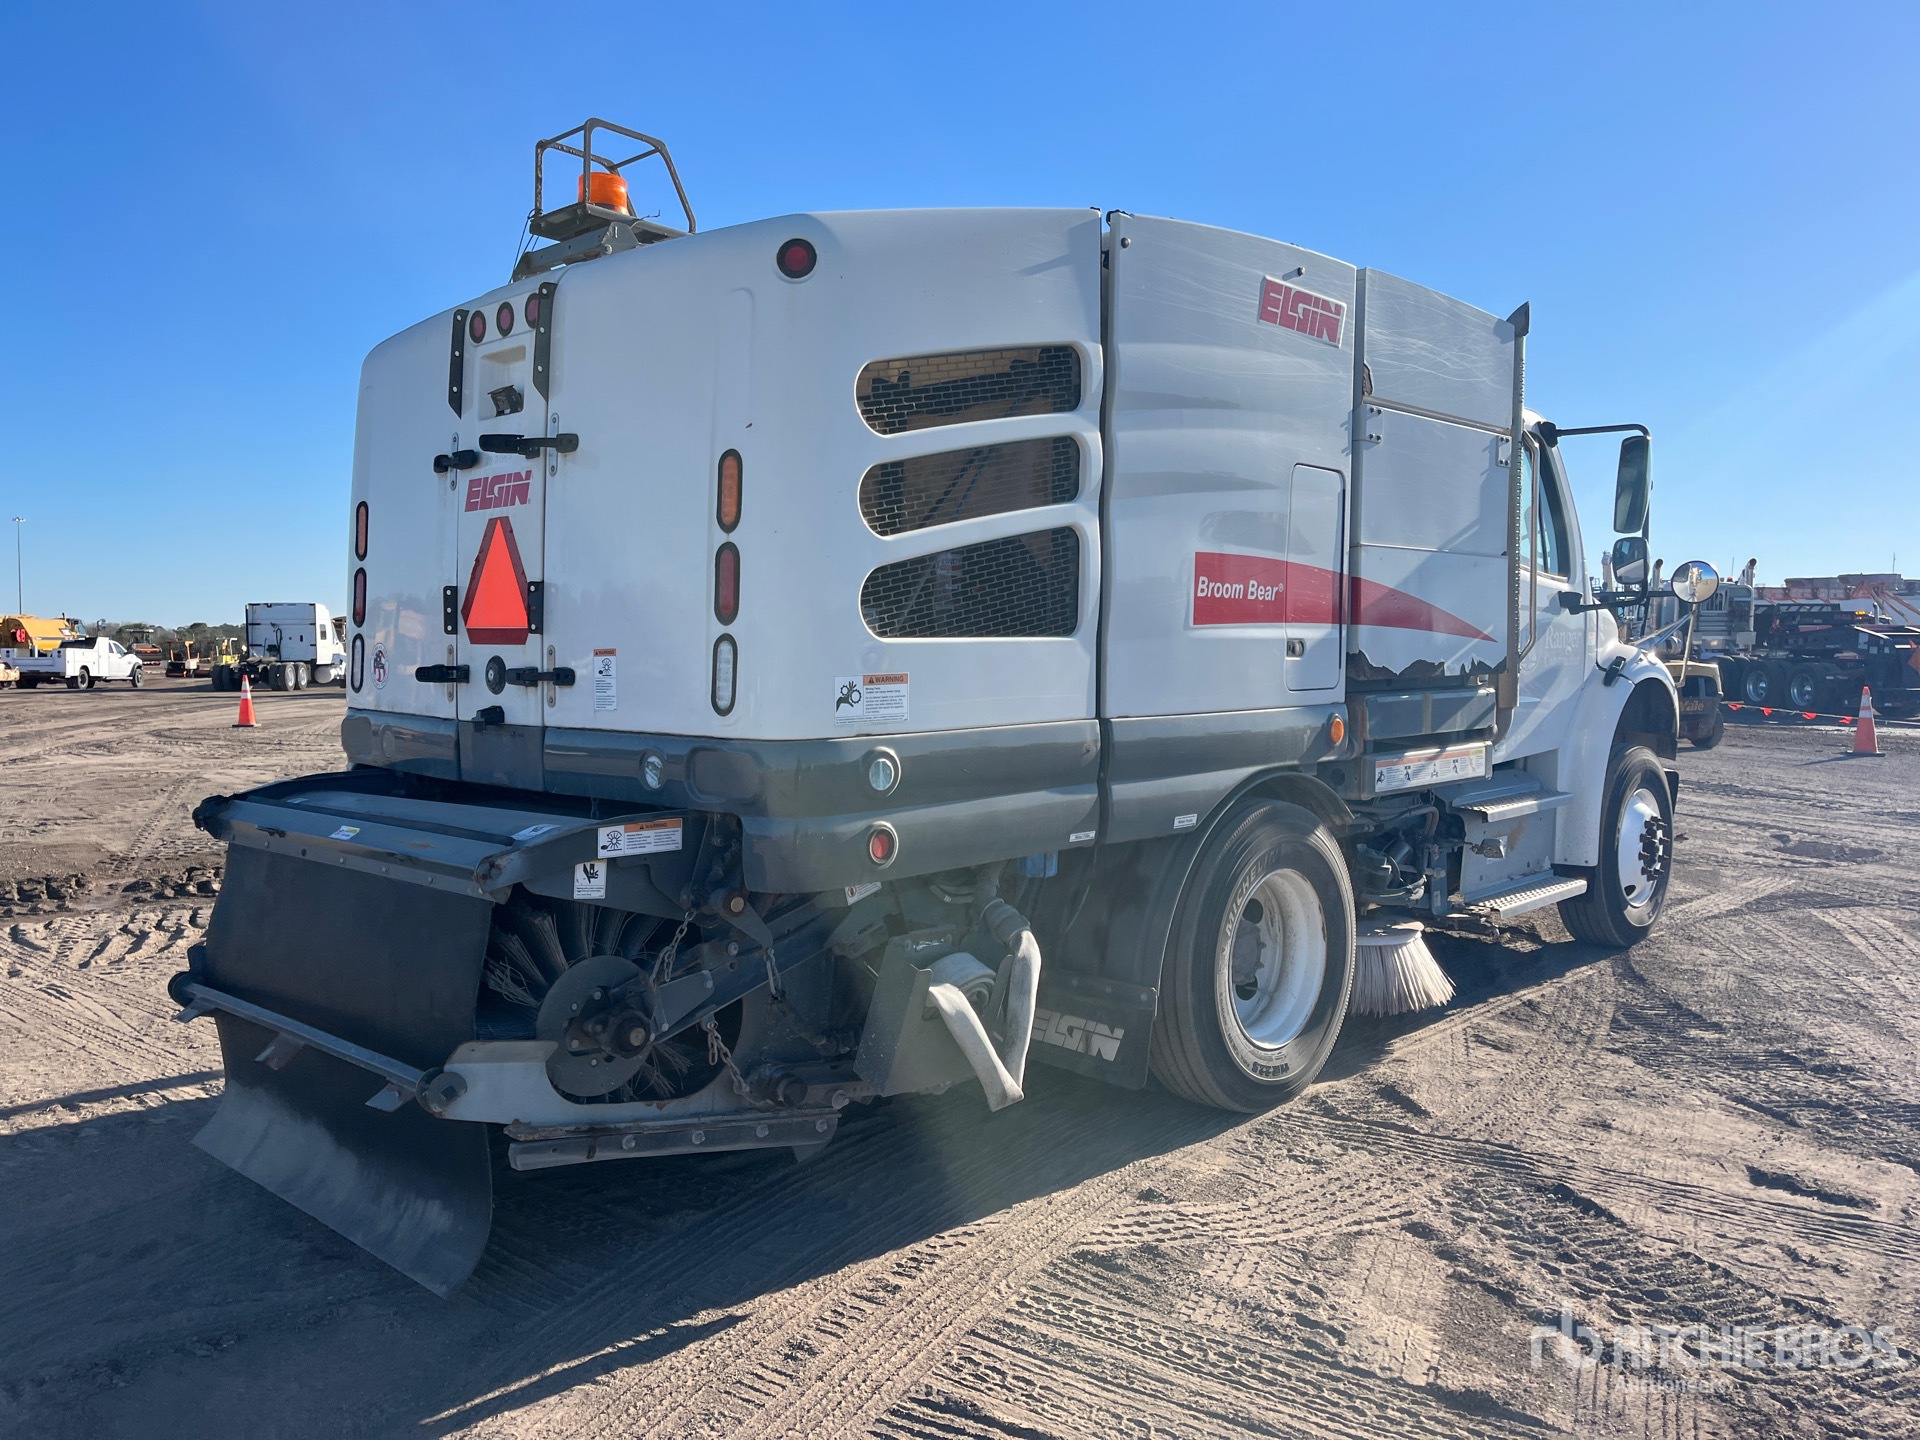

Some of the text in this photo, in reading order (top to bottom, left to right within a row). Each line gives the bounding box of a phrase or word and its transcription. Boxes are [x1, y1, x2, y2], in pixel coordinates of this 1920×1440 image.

[1260, 280, 1342, 343] ELGIN
[465, 470, 532, 512] ELGIN
[1197, 576, 1244, 599] Broom
[1544, 626, 1582, 655] Ranger
[875, 675, 904, 683] WARNING
[1030, 1007, 1125, 1062] ELGIN
